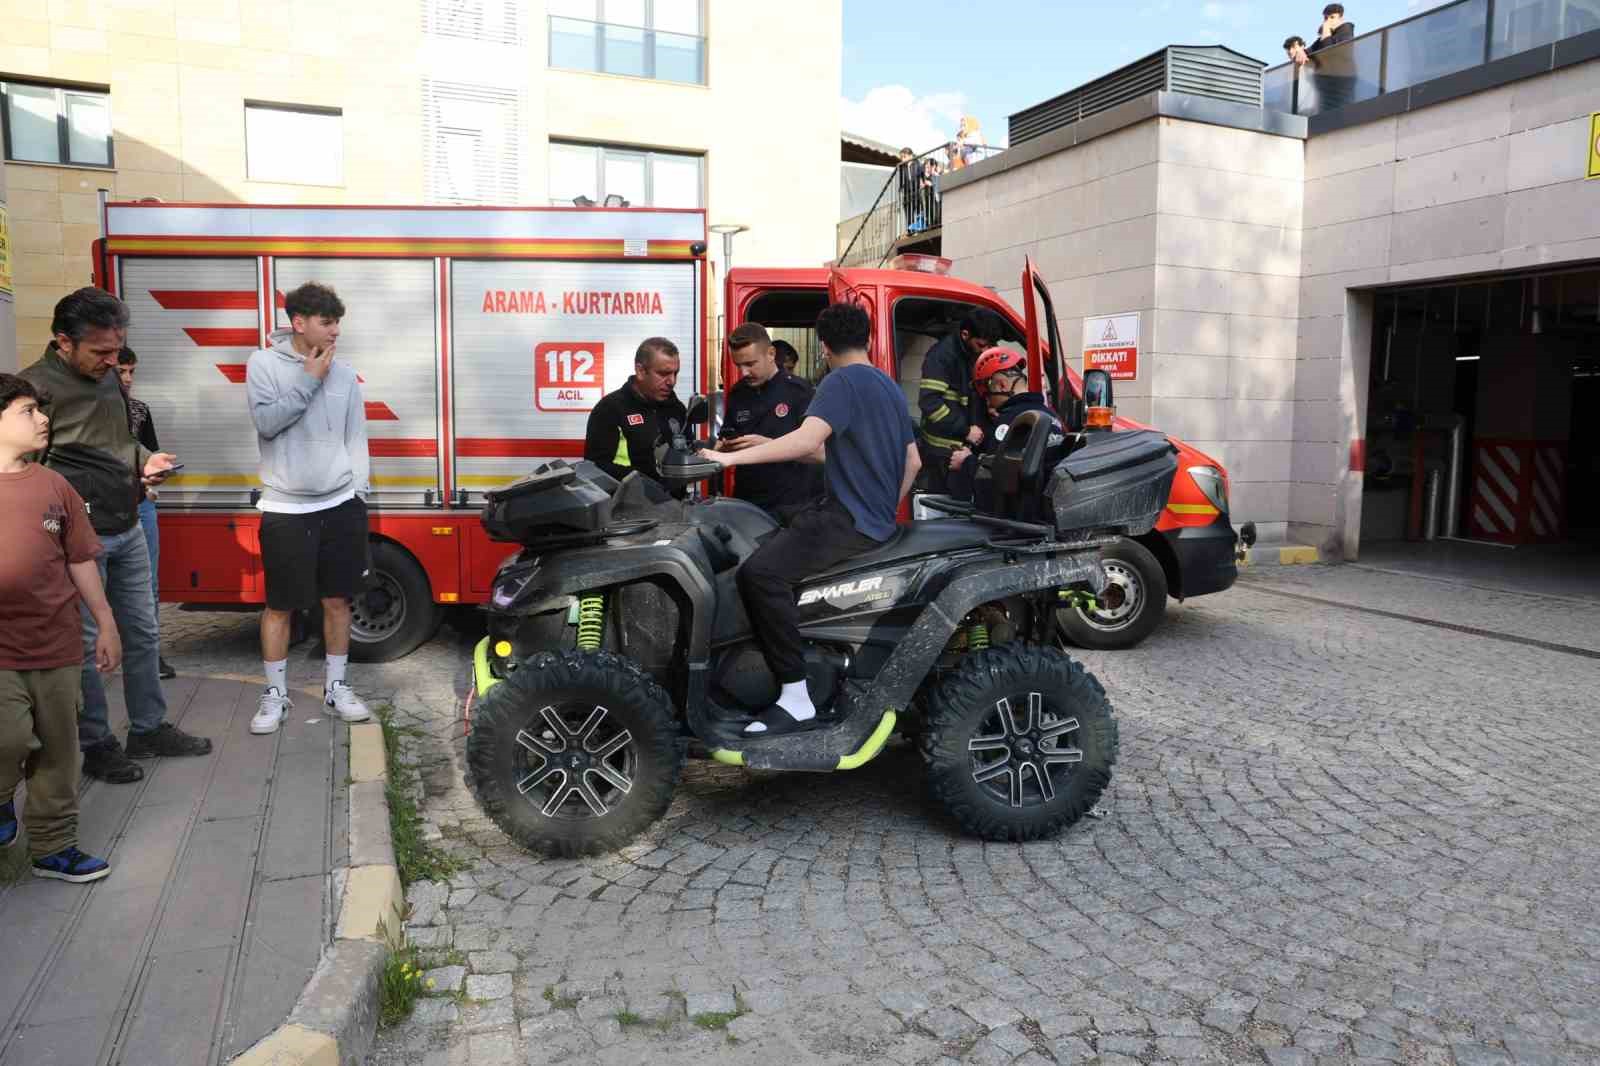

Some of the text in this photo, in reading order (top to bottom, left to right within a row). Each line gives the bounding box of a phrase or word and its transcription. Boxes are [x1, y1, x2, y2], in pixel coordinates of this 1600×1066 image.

[482, 290, 547, 314] ARAMA
[562, 291, 663, 315] KURTARMA
[1091, 351, 1128, 363] DİKKAT!
[544, 350, 595, 383] 112
[556, 389, 584, 401] ACİL
